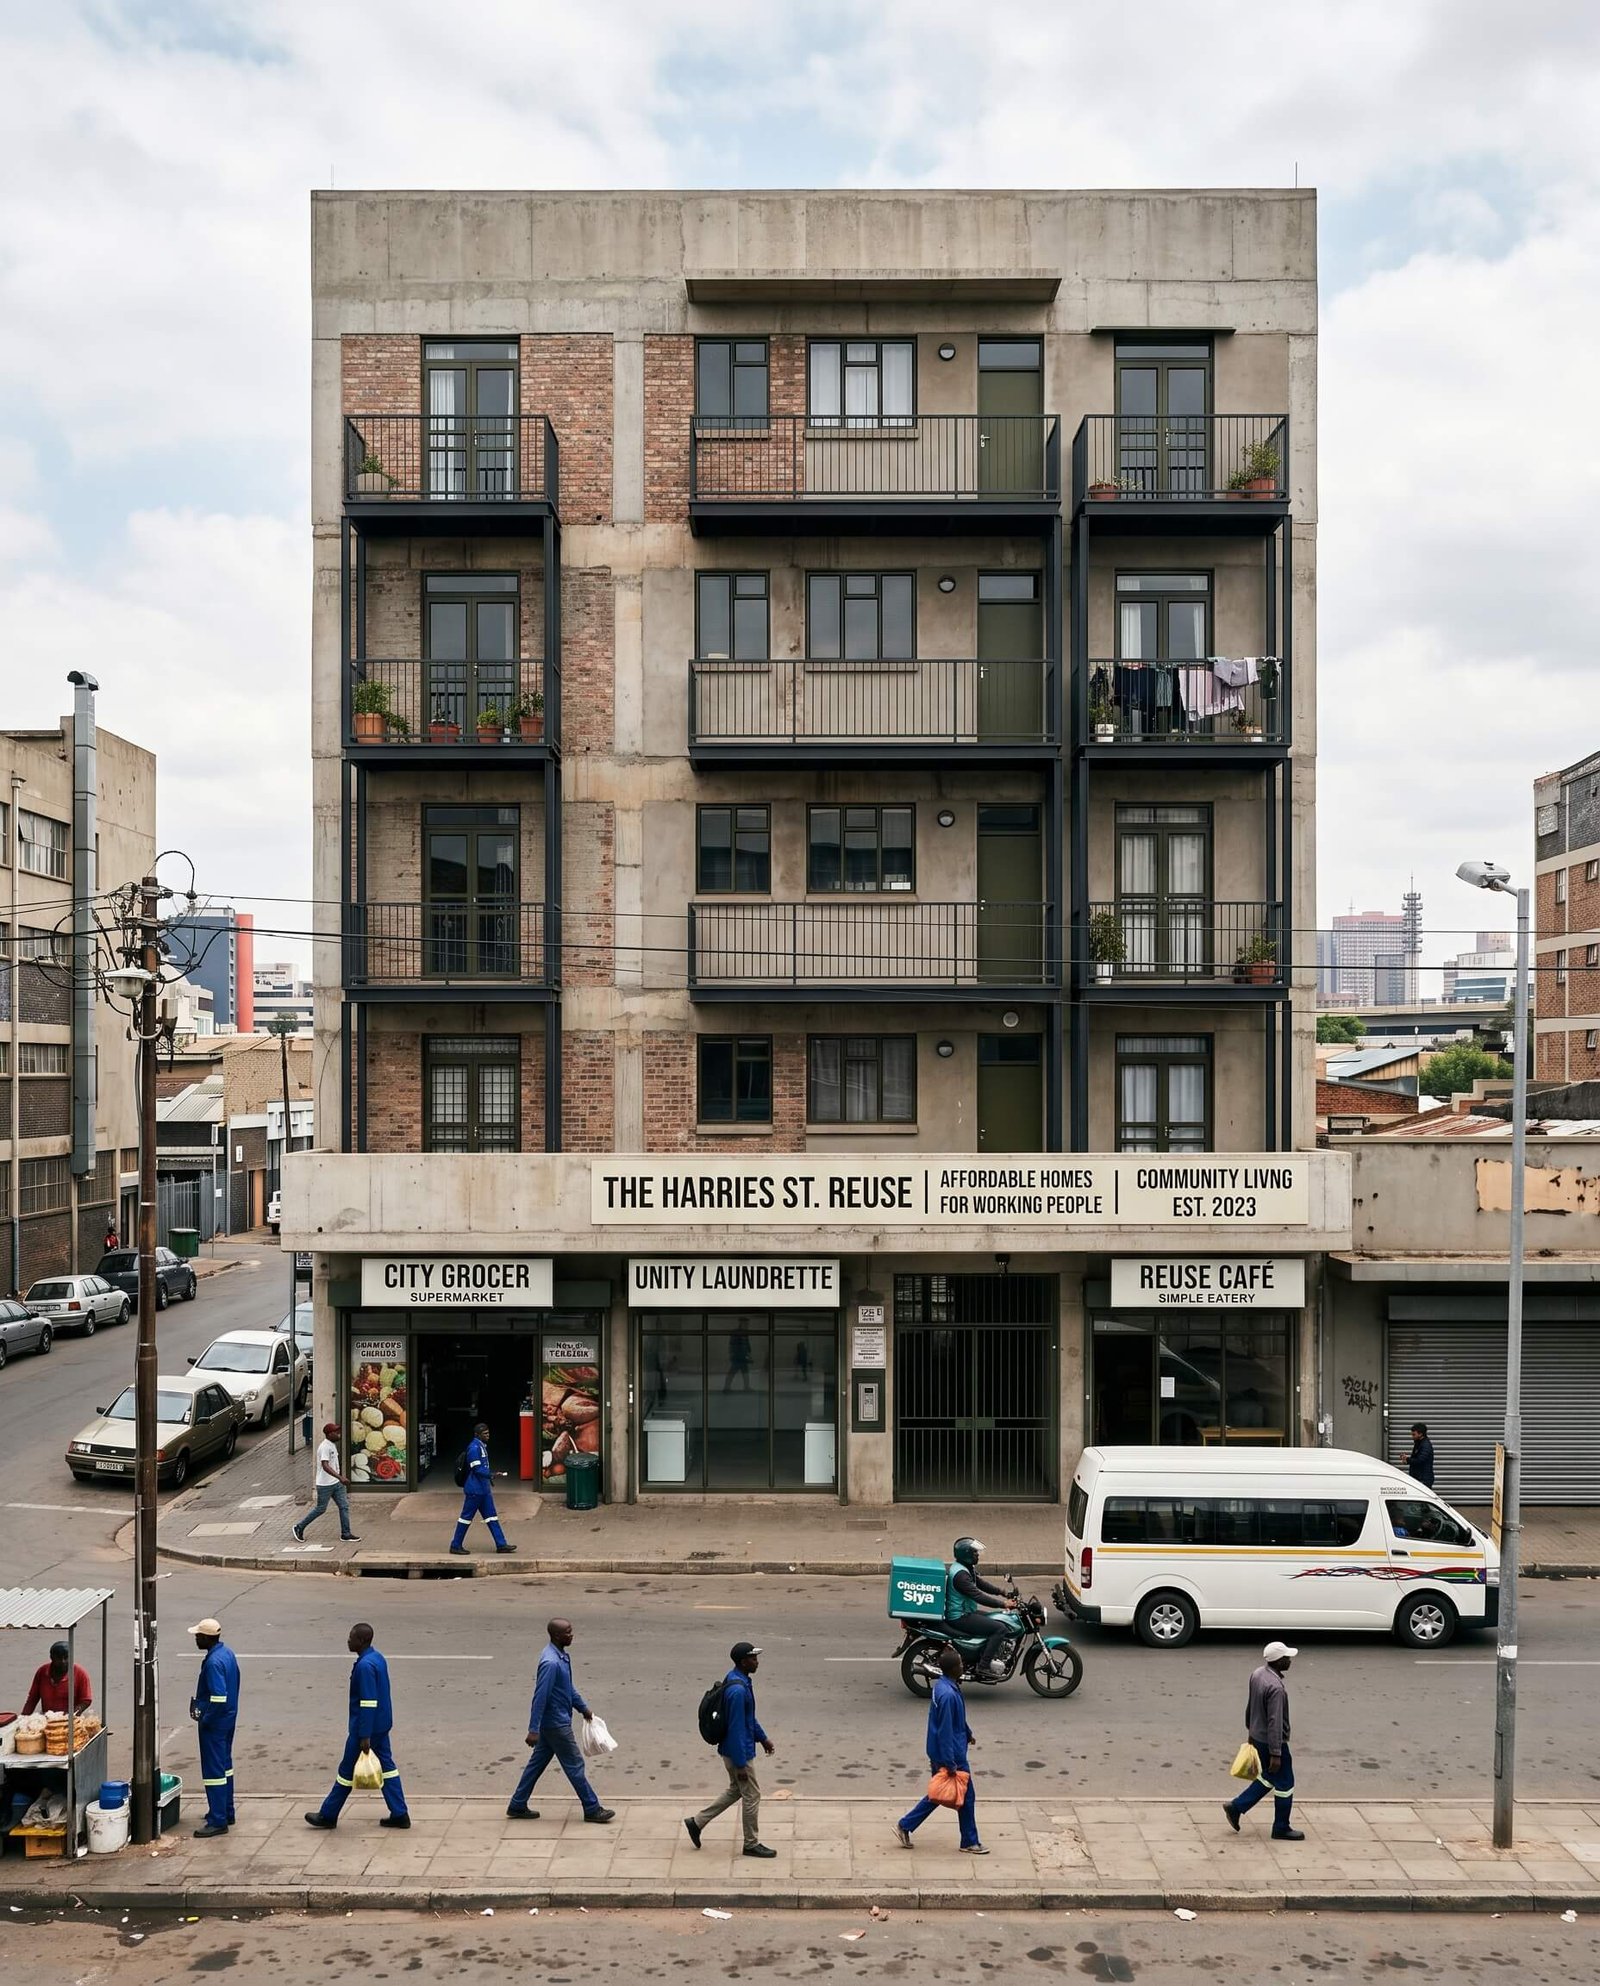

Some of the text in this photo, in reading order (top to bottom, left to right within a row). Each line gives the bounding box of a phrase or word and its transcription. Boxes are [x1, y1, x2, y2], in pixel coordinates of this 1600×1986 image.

[940, 1169, 1093, 1189] AFFORDABLE HOMES
[1137, 1168, 1293, 1189] COMMUNITY LIVNG
[603, 1176, 913, 1209] THE HARRIES ST. REUSE
[940, 1195, 1103, 1214] FOR WORKING PEOPLE
[1173, 1196, 1257, 1217] EST. 2023
[384, 1263, 530, 1289] CITY GROCER
[635, 1265, 833, 1290] UNITY LAUNDRETTE
[1140, 1260, 1275, 1289] REUSE CAFÉ
[410, 1292, 505, 1303] SUPERMARKET
[1158, 1293, 1256, 1304] SIMPLE EATERY
[897, 1581, 941, 1592] Checkers
